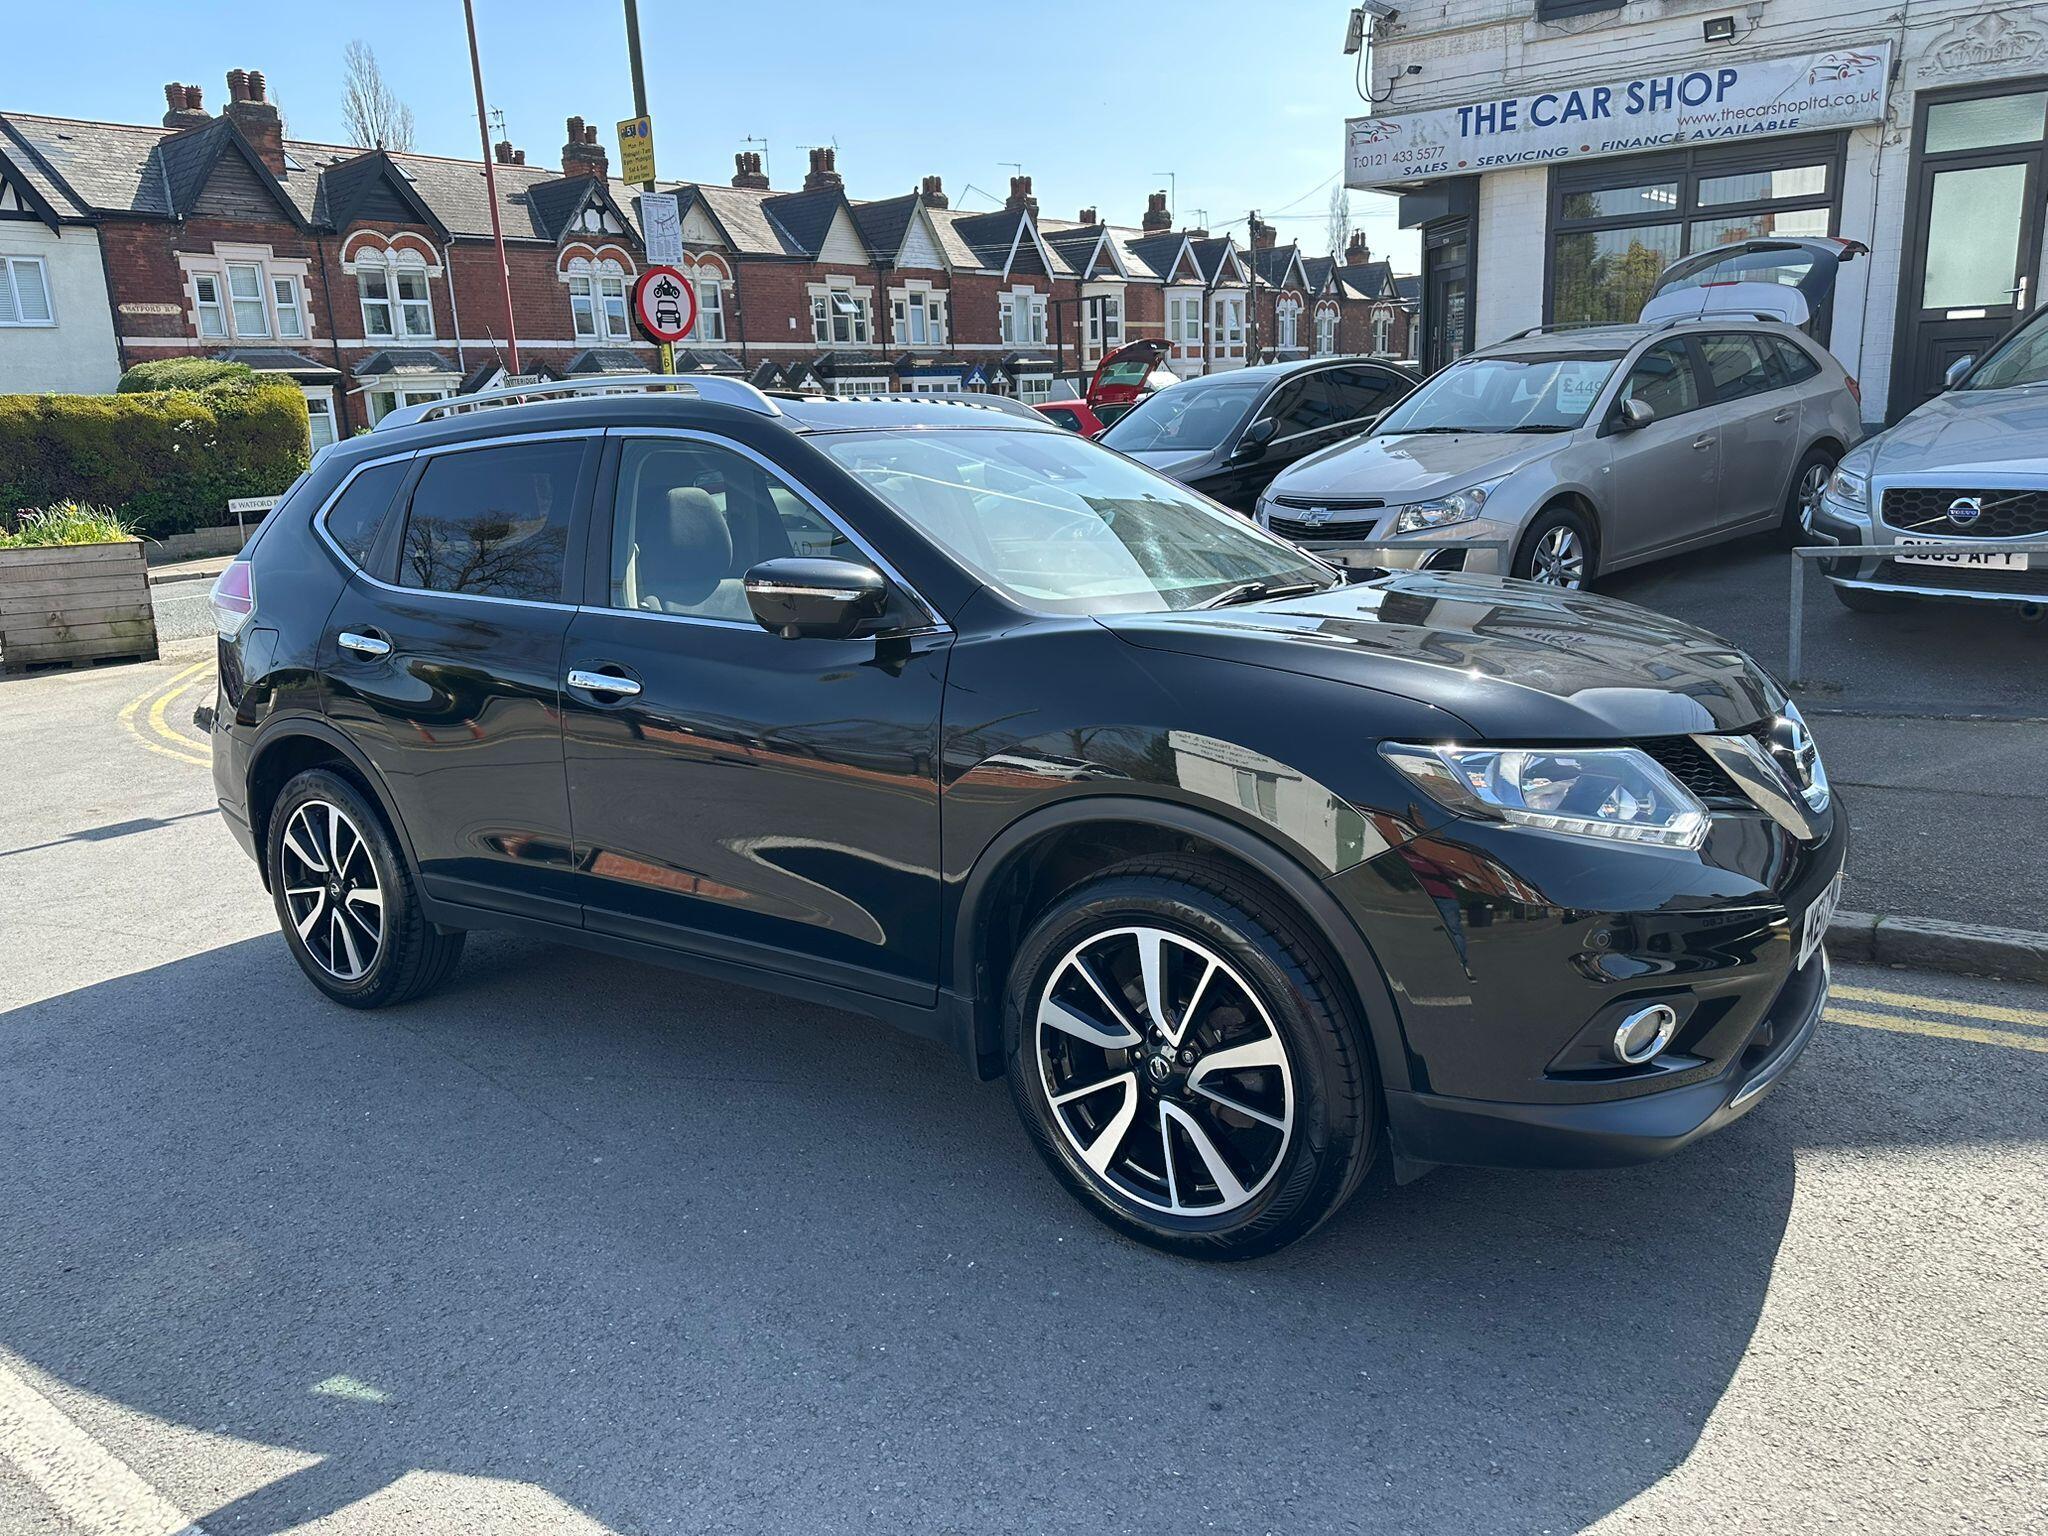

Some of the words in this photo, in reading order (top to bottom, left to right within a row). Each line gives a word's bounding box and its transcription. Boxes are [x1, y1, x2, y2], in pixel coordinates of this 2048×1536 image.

[1457, 100, 1517, 137] THE
[1530, 86, 1612, 127] CAR
[1624, 68, 1738, 115] SHOP
[1677, 88, 1880, 126] www.thecarshopltd.co.uk
[1392, 149, 1413, 163] 433
[1416, 146, 1446, 161] 5577
[1403, 161, 1448, 176] SALES
[1476, 146, 1569, 167] SERVICING
[1601, 131, 1686, 151] FINANCE
[1690, 117, 1800, 140] AVAILABLE
[238, 500, 272, 508] WATFORD
